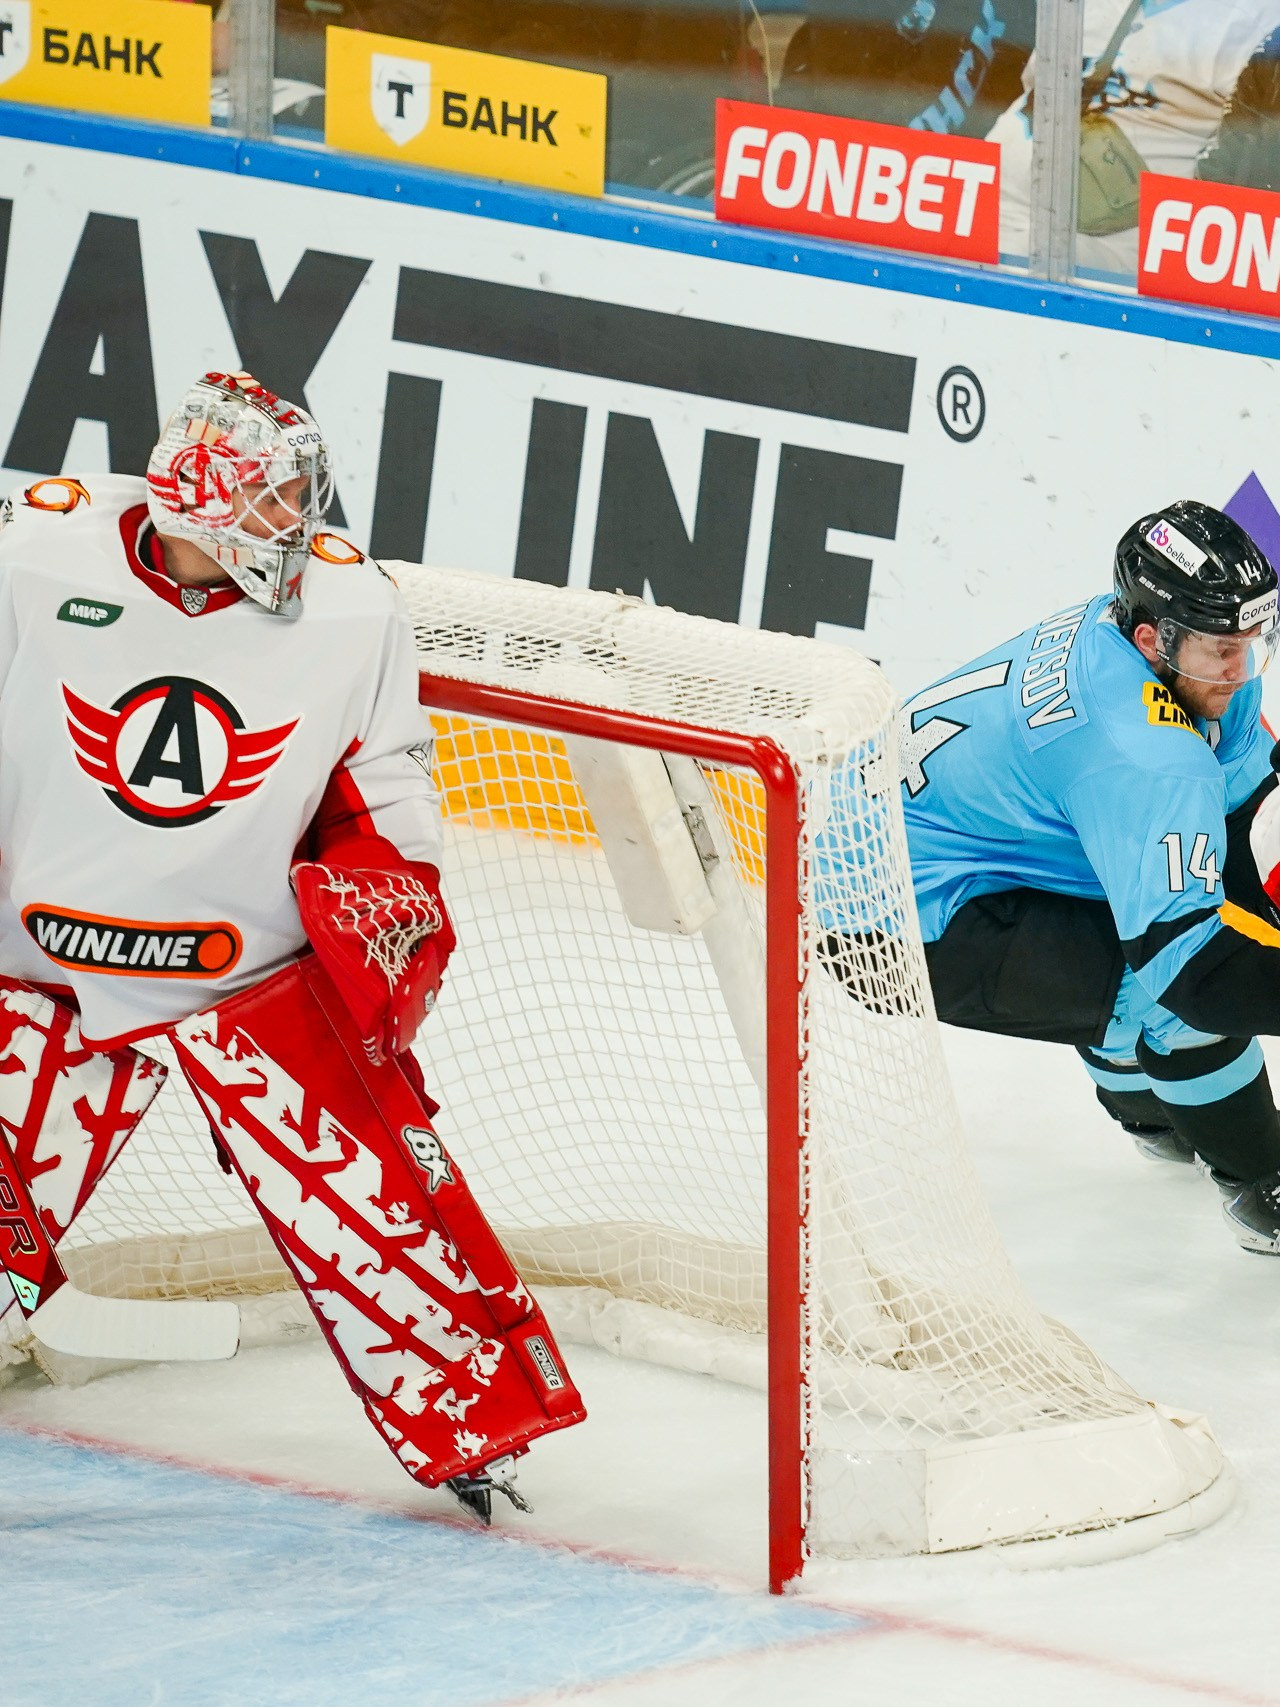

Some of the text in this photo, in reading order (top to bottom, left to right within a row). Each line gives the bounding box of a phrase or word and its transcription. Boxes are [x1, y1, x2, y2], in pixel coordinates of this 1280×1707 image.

[43, 27, 163, 78] БАНК
[388, 79, 559, 147] Т БАНК
[720, 125, 996, 238] FONBET
[1165, 543, 1196, 573] belbet
[1234, 559, 1262, 587] 14
[69, 602, 109, 621] МИР
[1241, 598, 1277, 621] согаз
[1020, 596, 1090, 730] NETSOV
[1158, 832, 1221, 895] 14
[34, 917, 197, 968] WINLINE
[528, 1338, 558, 1378] ICONIK
